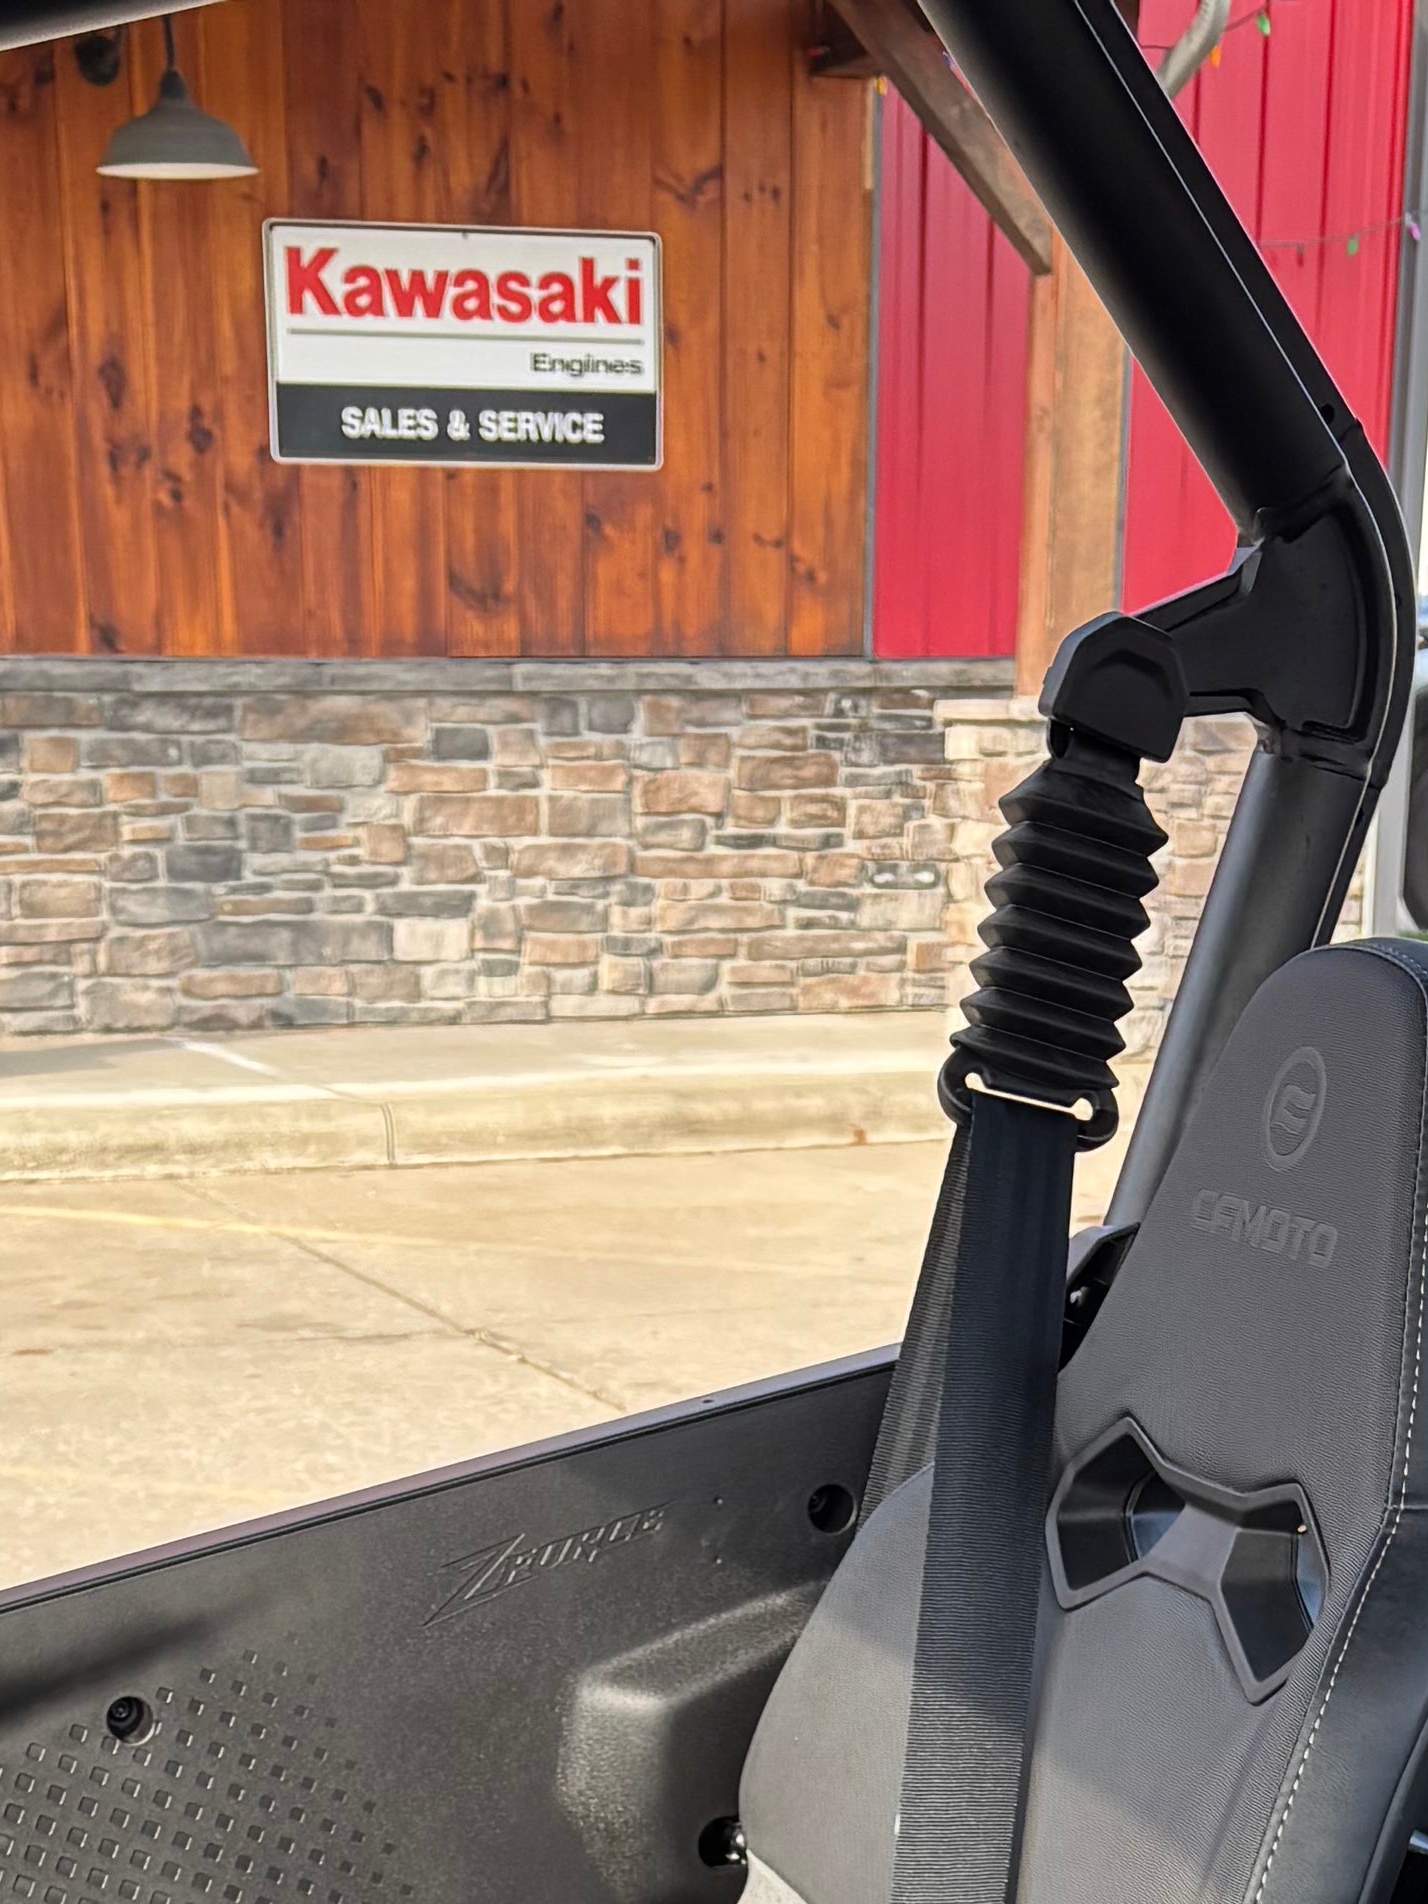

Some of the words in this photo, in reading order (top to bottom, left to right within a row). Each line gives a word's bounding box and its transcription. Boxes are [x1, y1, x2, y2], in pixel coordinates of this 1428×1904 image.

[285, 245, 641, 324] Kawasaki
[530, 353, 644, 377] Engines
[341, 406, 438, 439] SALES
[448, 409, 470, 439] &
[479, 410, 604, 443] SERVICE
[1192, 1188, 1339, 1268] CFMOTO
